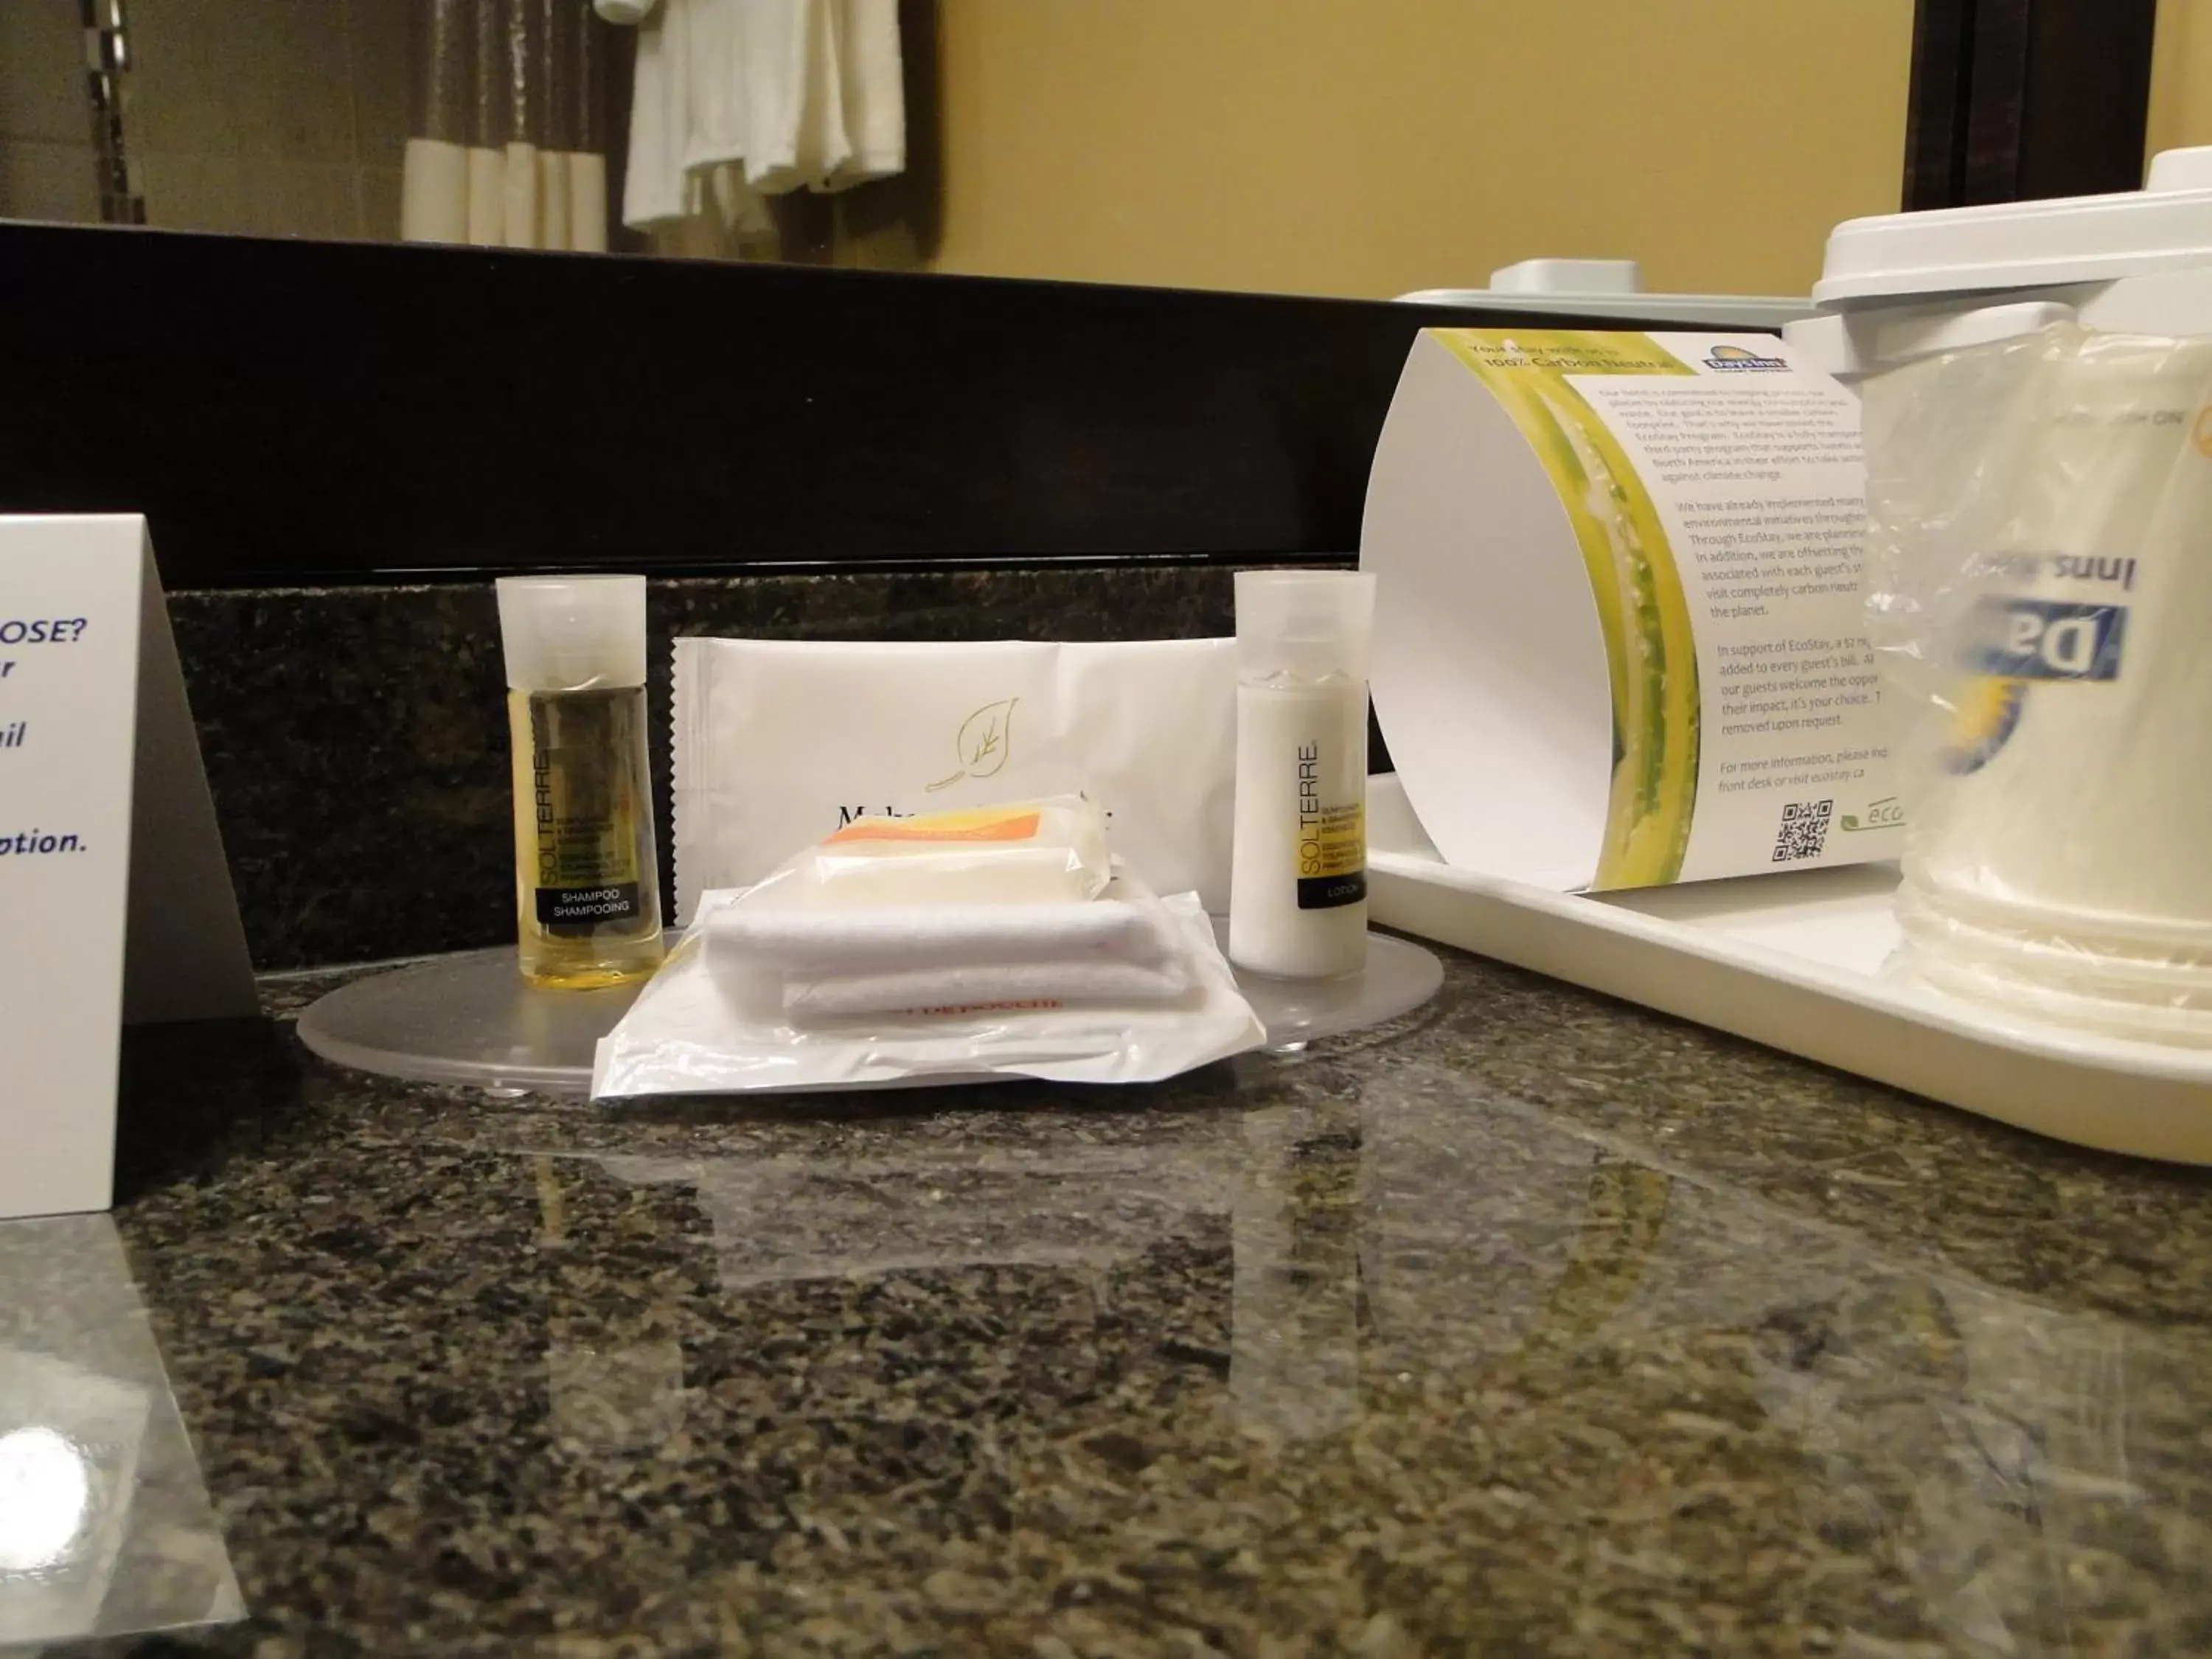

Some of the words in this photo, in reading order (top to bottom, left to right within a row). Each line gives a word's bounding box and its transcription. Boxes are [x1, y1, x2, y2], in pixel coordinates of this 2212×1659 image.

[1484, 357, 1531, 367] 100%
[1532, 356, 1601, 368] Carbon
[1600, 358, 1674, 369] Neutral
[1677, 502, 1694, 512] We
[1695, 501, 1722, 512] have
[1725, 499, 1764, 515] already
[1766, 497, 1834, 510] implemented
[1683, 516, 1761, 529] environmental
[1764, 514, 1814, 526] initiatives
[1688, 534, 1736, 549] Through
[1738, 531, 1785, 546] EcoStay,
[1785, 532, 1804, 542] we
[1804, 532, 1821, 542] are
[1697, 552, 1708, 563] In
[1709, 549, 1759, 563] addition,
[1759, 551, 1777, 560] we
[1777, 550, 1795, 560] are
[1796, 546, 1848, 560] offsetting
[1701, 567, 1759, 582] associated
[1761, 566, 1785, 577] with
[1787, 564, 1812, 577] each
[1814, 561, 1853, 579] guest's
[2054, 555, 2137, 591] Inns
[1705, 588, 1728, 599] visit
[1730, 584, 1790, 603] completely
[1791, 582, 1829, 597] carbon
[1710, 605, 1731, 619] the
[1732, 604, 1770, 620] planet.
[0, 617, 87, 644] OSE?
[1717, 644, 1730, 657] In
[1730, 643, 1772, 659] support
[1772, 640, 1787, 653] of
[1788, 639, 1834, 653] EcoStay,
[1834, 639, 1842, 648] a
[1719, 658, 1753, 677] added
[1756, 661, 1768, 674] to
[1770, 660, 1799, 675] every
[1801, 655, 1840, 672] guest's
[1840, 653, 1860, 668] bill.
[1721, 684, 1740, 696] our
[1742, 681, 1778, 698] guests
[1778, 678, 1828, 692] welcome
[1829, 674, 1847, 688] the
[1722, 703, 1747, 716] their
[1749, 700, 1789, 716] impact,
[1790, 696, 1806, 709] it's
[1808, 696, 1834, 712] your
[1834, 693, 1873, 706] choice.
[0, 721, 26, 748] il
[1721, 721, 1770, 736] removed
[1771, 719, 1800, 732] upon
[1801, 714, 1843, 731] request.
[1719, 761, 1737, 774] For
[1740, 760, 1770, 772] more
[1770, 753, 1834, 769] information,
[1836, 749, 1870, 765] please
[1717, 779, 1745, 793] front
[1747, 776, 1773, 790] desk
[1774, 776, 1787, 787] or
[1787, 773, 1809, 785] visit
[1810, 768, 1865, 784] ecostay.ca
[561, 888, 620, 903] SHAMPOO
[553, 900, 630, 917] SHAMPOOING
